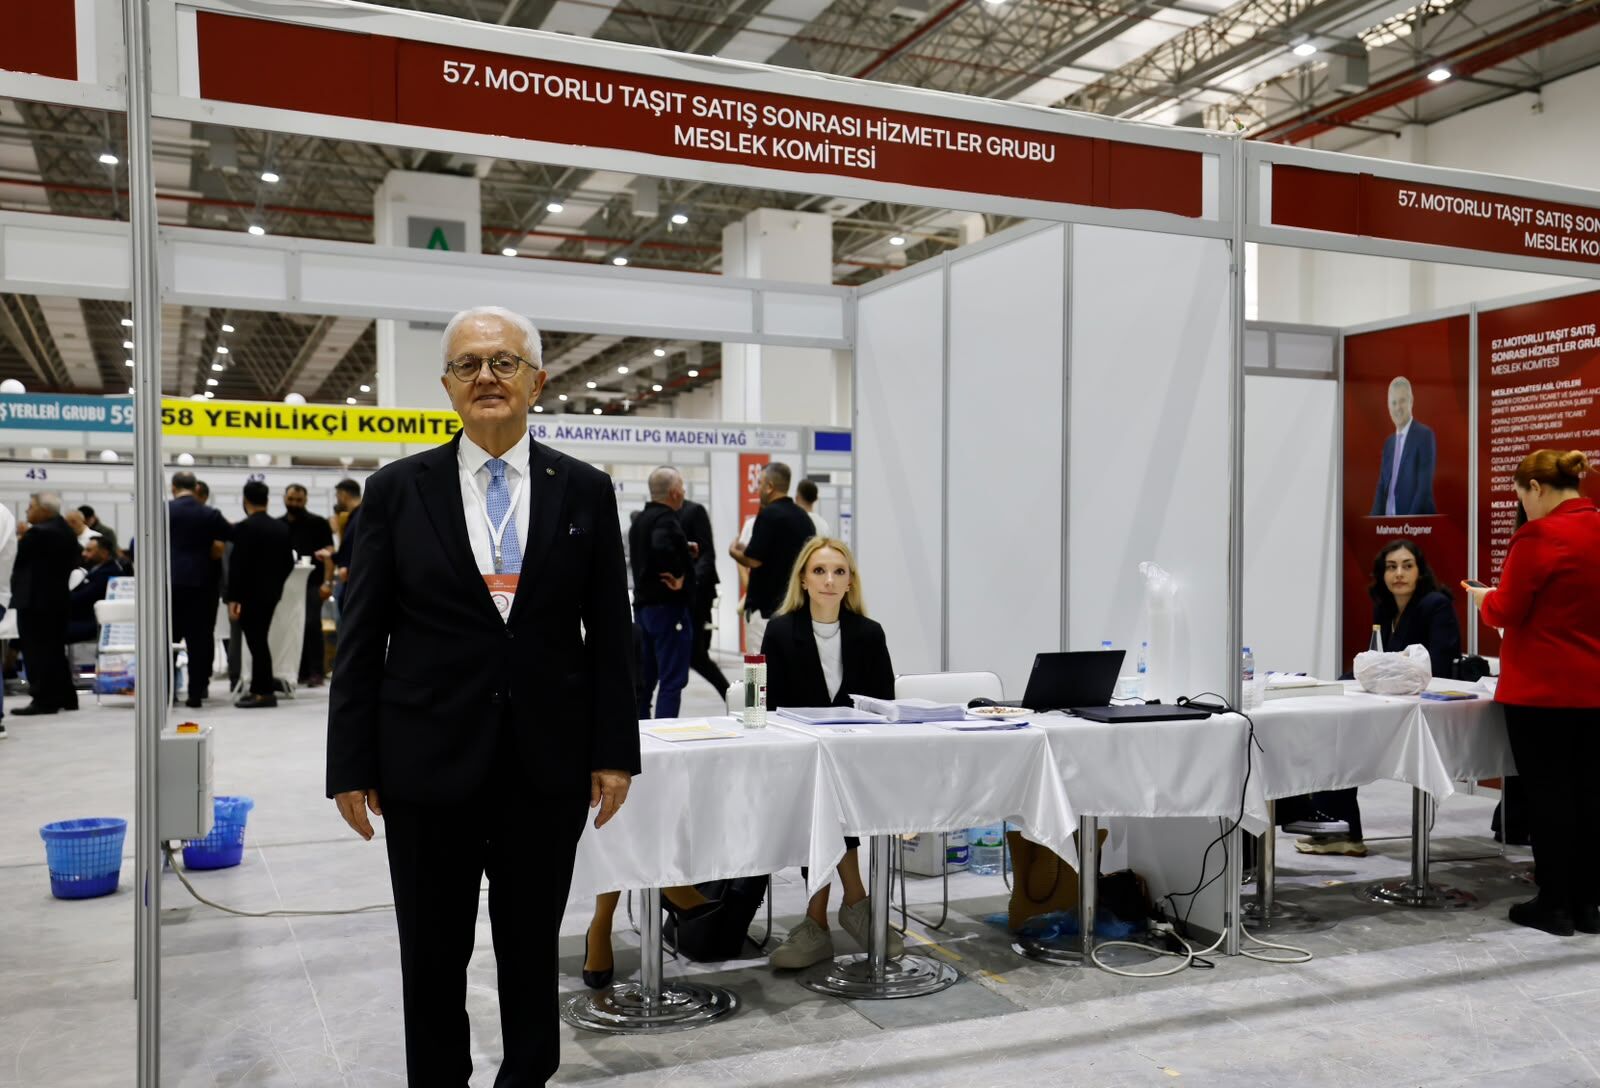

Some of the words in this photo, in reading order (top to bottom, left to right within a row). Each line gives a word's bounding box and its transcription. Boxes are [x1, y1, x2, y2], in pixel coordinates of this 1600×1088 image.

[443, 60, 480, 87] 57.
[485, 66, 613, 105] MOTORLU
[619, 86, 687, 117] TAŞIT
[693, 96, 758, 128] SATIŞ
[763, 106, 860, 138] SONRASI
[866, 117, 982, 154] HİZMETLER
[986, 137, 1055, 163] GRUBU
[674, 125, 768, 156] MESLEK
[773, 139, 876, 170] KOMİTESİ
[1399, 190, 1419, 208] 57.
[1422, 193, 1492, 218] MOTORLU
[1495, 204, 1533, 226] TAŞIT
[1536, 210, 1573, 234] SATIŞ
[1525, 232, 1578, 254] MESLEK
[1504, 332, 1544, 348] MOTORLU
[1546, 328, 1570, 342] TAŞIT
[1571, 324, 1596, 337] SATIŞ
[1492, 349, 1527, 363] SONRASI
[1529, 342, 1576, 357] HİZMETLER
[1492, 363, 1522, 375] MESLEK
[1523, 356, 1560, 371] KOMİTESİ
[8, 402, 60, 420] YERLERİ
[62, 406, 106, 422] GRUBU
[110, 405, 134, 425] 59
[161, 408, 194, 426] 58
[206, 407, 349, 435] YENİLİKÇİ
[556, 426, 632, 442] AKARYAKIT
[636, 429, 661, 444] LPG
[666, 430, 719, 445] MADENİ
[722, 430, 747, 446] YAĞ
[26, 468, 47, 480] 43
[1376, 525, 1403, 535] Mahmut
[1404, 524, 1432, 536] Özgener
